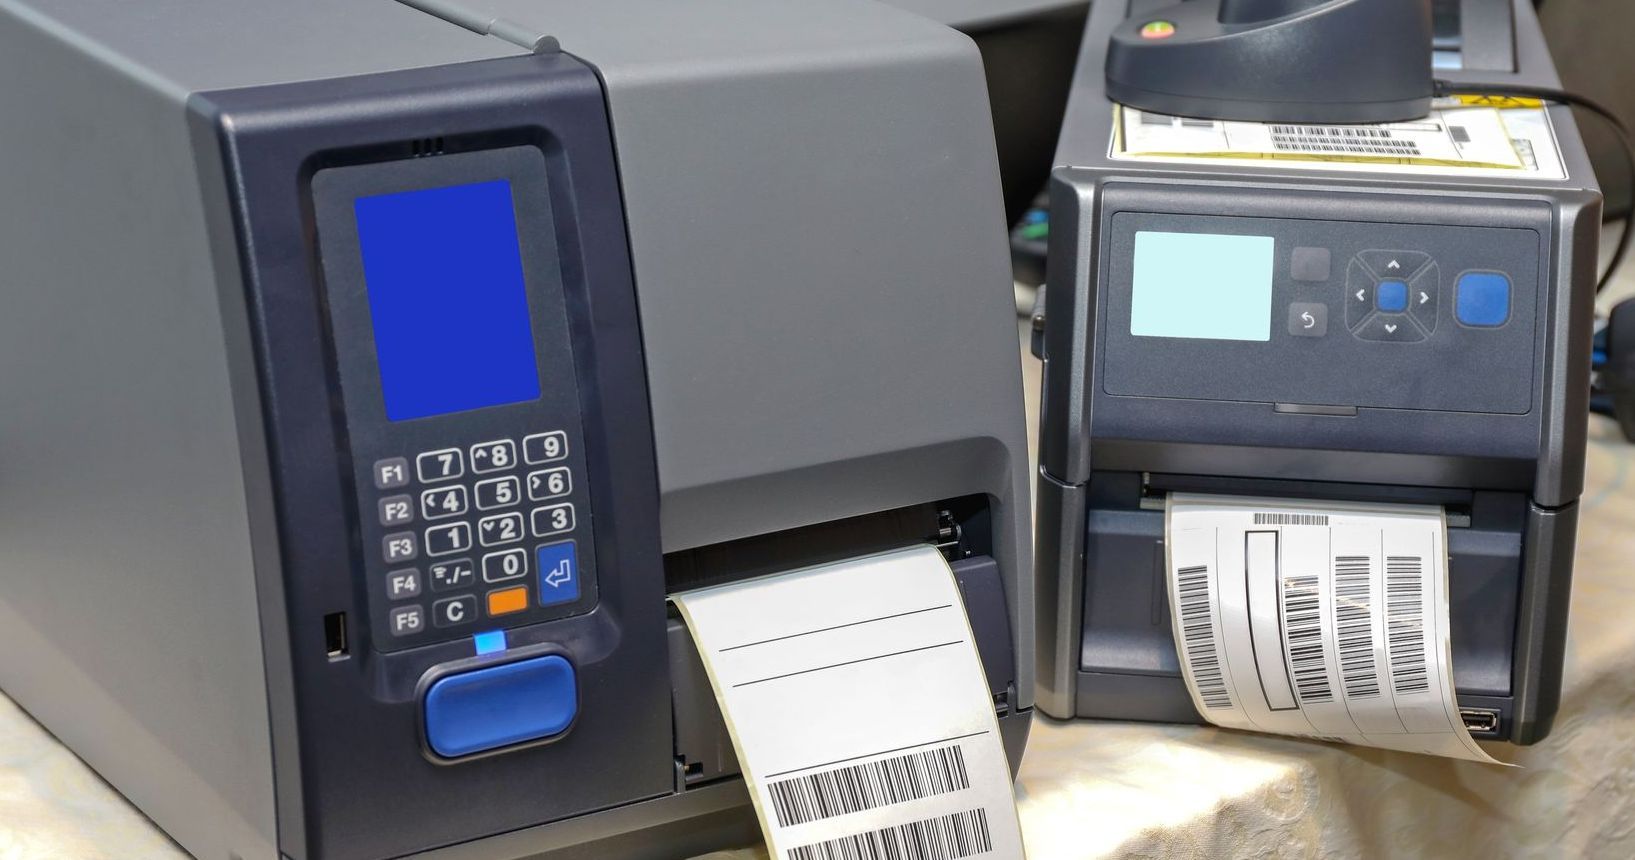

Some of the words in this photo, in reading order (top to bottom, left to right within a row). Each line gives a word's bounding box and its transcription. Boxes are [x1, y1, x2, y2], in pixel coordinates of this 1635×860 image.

[381, 466, 403, 484] F1
[438, 455, 453, 475] 7
[492, 446, 507, 466] 8
[544, 437, 559, 457] 9
[385, 503, 408, 521] F2
[442, 491, 458, 512] 4
[496, 483, 511, 503] 5
[548, 473, 563, 493] 6
[389, 540, 412, 557] F3
[448, 528, 460, 548] 1
[500, 519, 515, 539] 2
[552, 509, 567, 529] 3
[393, 576, 416, 594] F4
[503, 555, 518, 575] 0
[396, 613, 419, 631] F5
[446, 602, 463, 621] C
